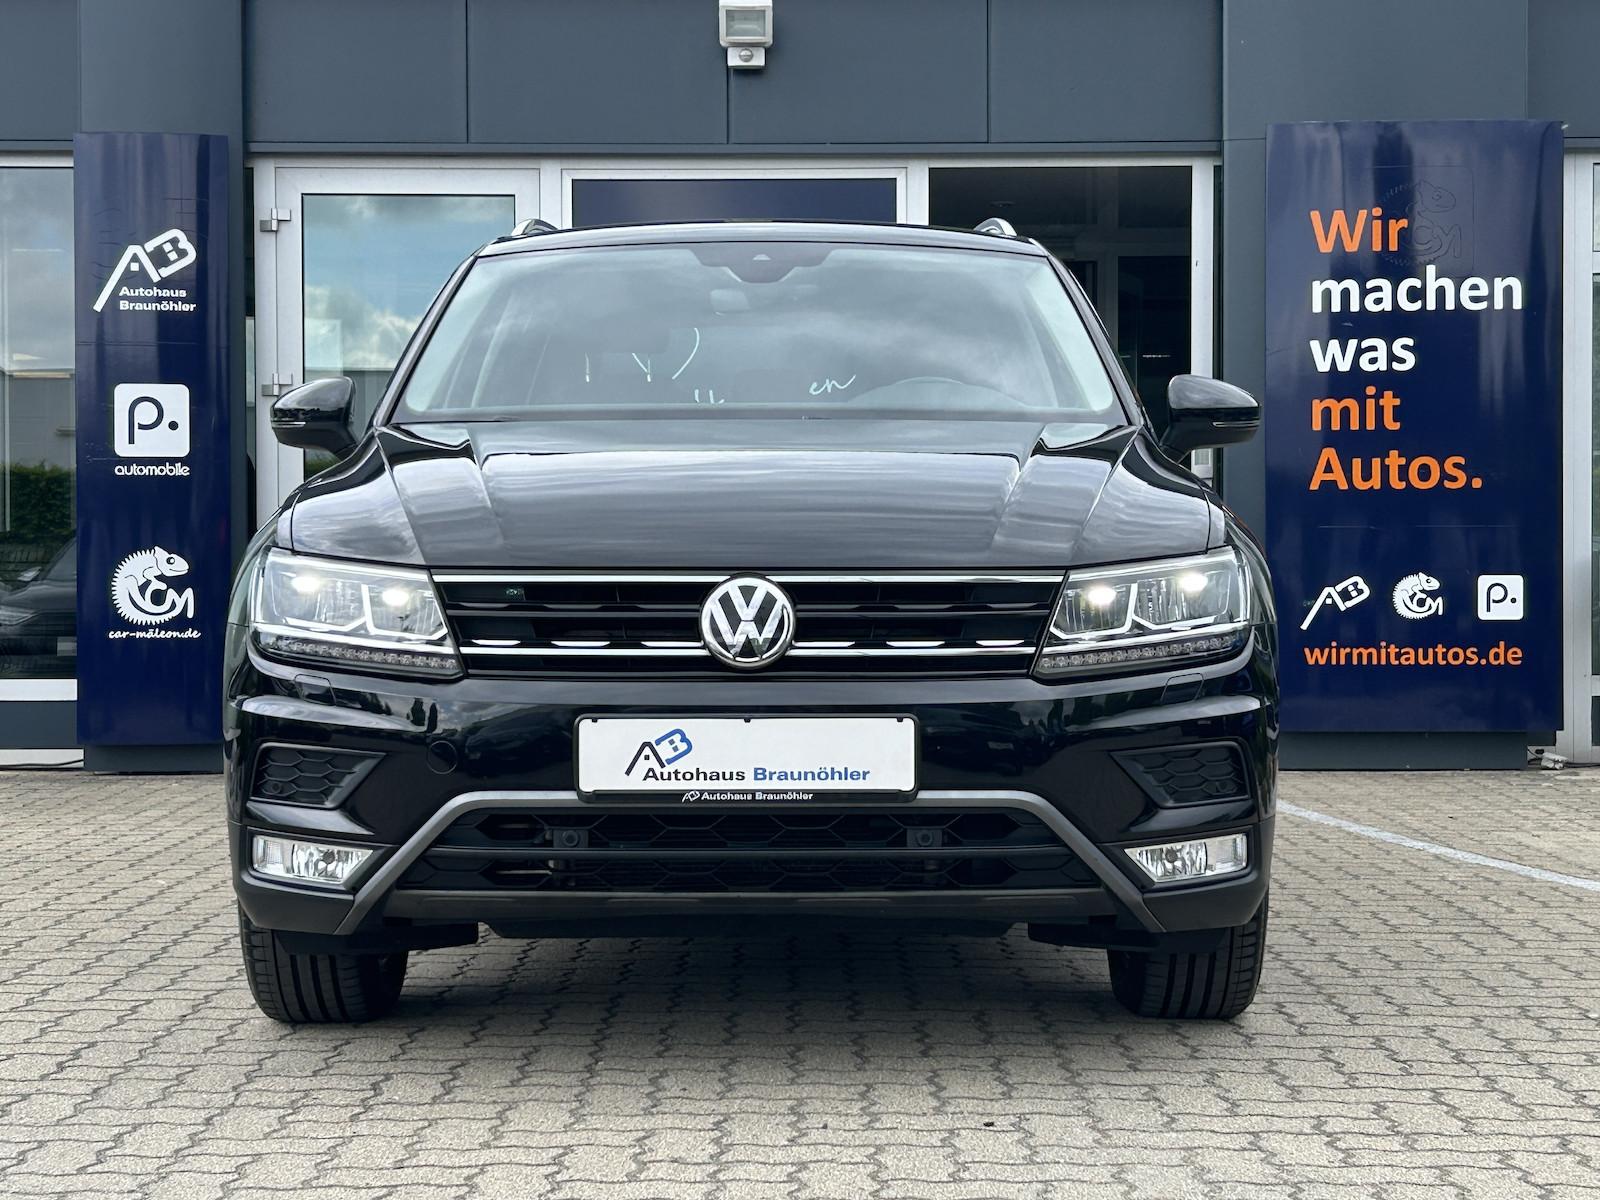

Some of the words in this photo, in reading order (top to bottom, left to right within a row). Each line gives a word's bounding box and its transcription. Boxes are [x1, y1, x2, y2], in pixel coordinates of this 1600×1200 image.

[1309, 207, 1408, 253] Wir
[118, 286, 187, 298] Autohaus
[1311, 264, 1523, 313] machen
[119, 299, 197, 312] Braunöhler
[1309, 336, 1416, 372] was
[1311, 385, 1401, 431] mit
[114, 462, 191, 476] automobile
[1309, 446, 1483, 490] Autos.
[701, 577, 794, 667] VW
[1303, 640, 1523, 666] wirmitautos.de
[642, 767, 746, 781] Autohaus
[753, 767, 871, 781] Braunöhler
[701, 791, 753, 801] Autohaus
[755, 791, 814, 801] Braunöhler
